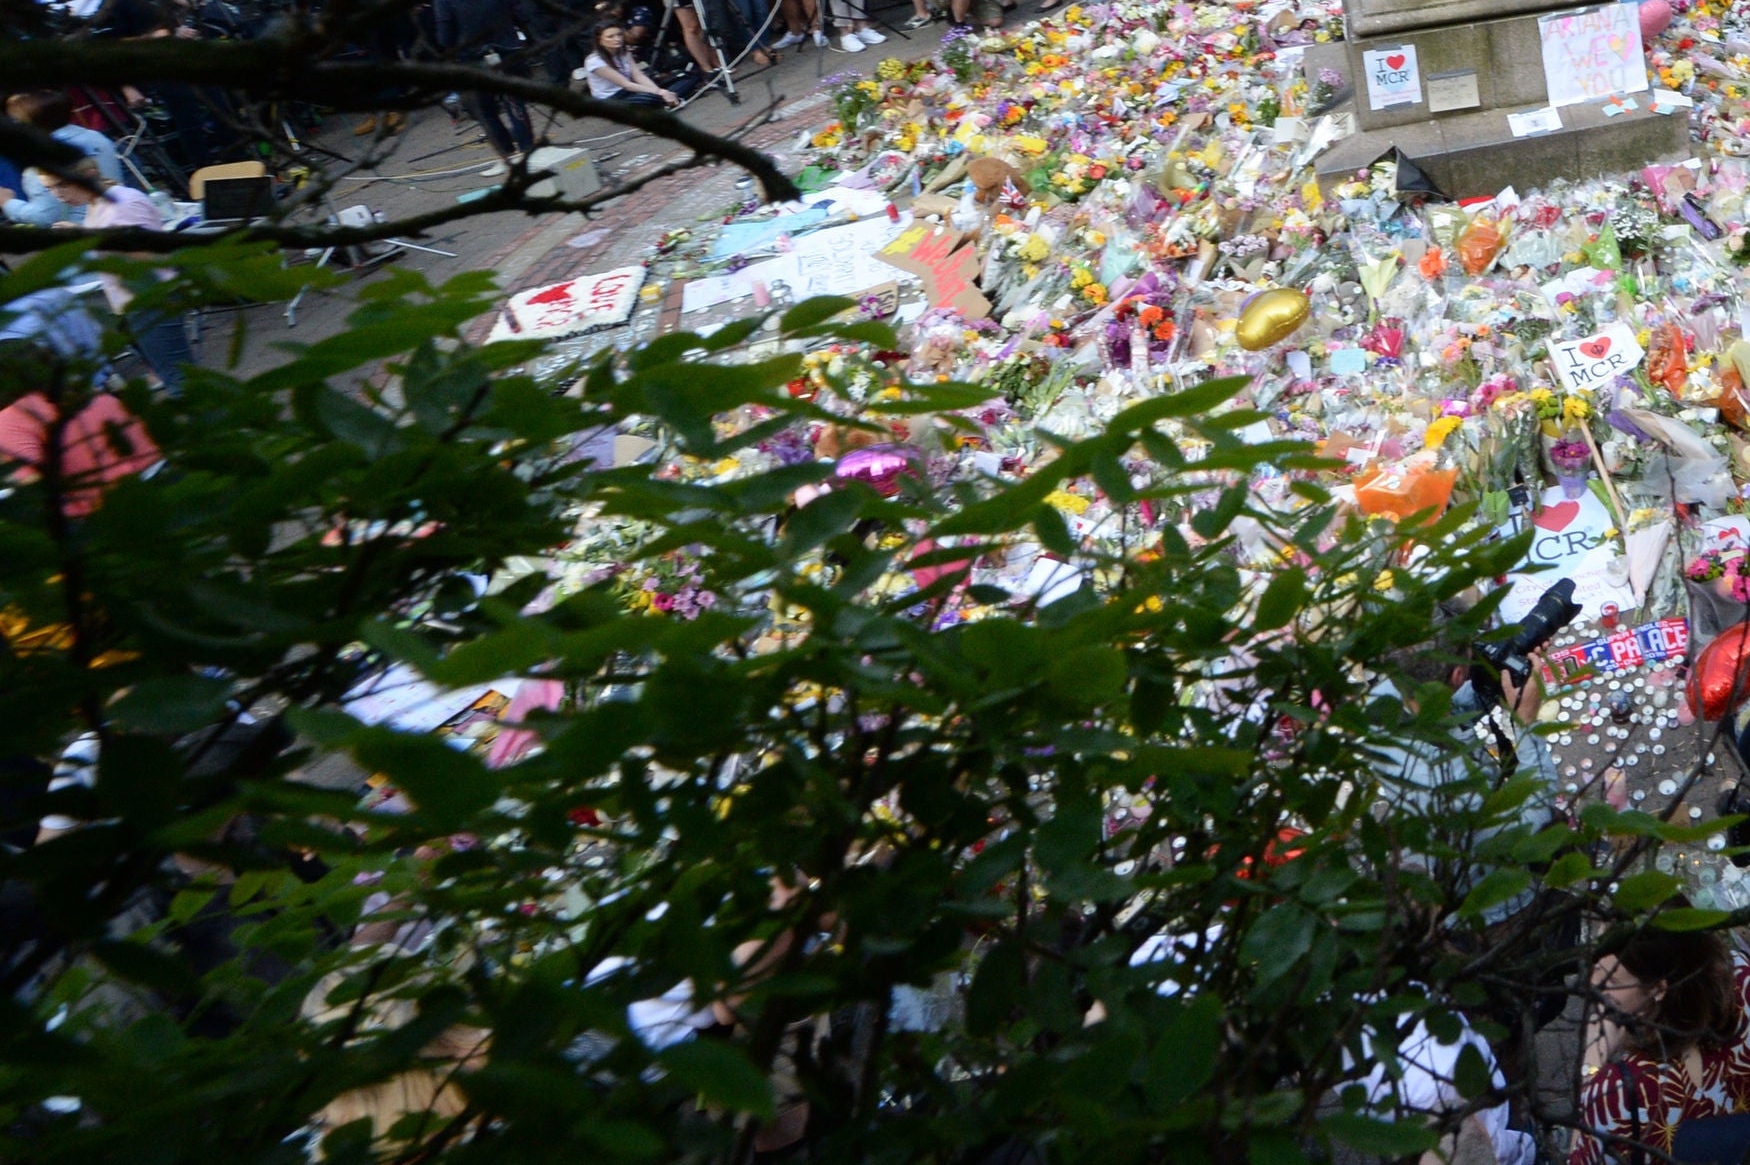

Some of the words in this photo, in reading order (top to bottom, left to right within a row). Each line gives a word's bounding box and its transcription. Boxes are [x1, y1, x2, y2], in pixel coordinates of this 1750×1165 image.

[1543, 5, 1631, 41] ARIANA
[1376, 58, 1387, 74] I
[1564, 35, 1608, 68] WE
[1376, 70, 1410, 86] MCR
[1575, 67, 1626, 95] YOU
[1561, 347, 1584, 368] I
[1569, 353, 1629, 388] MCR
[1526, 531, 1595, 564] CR
